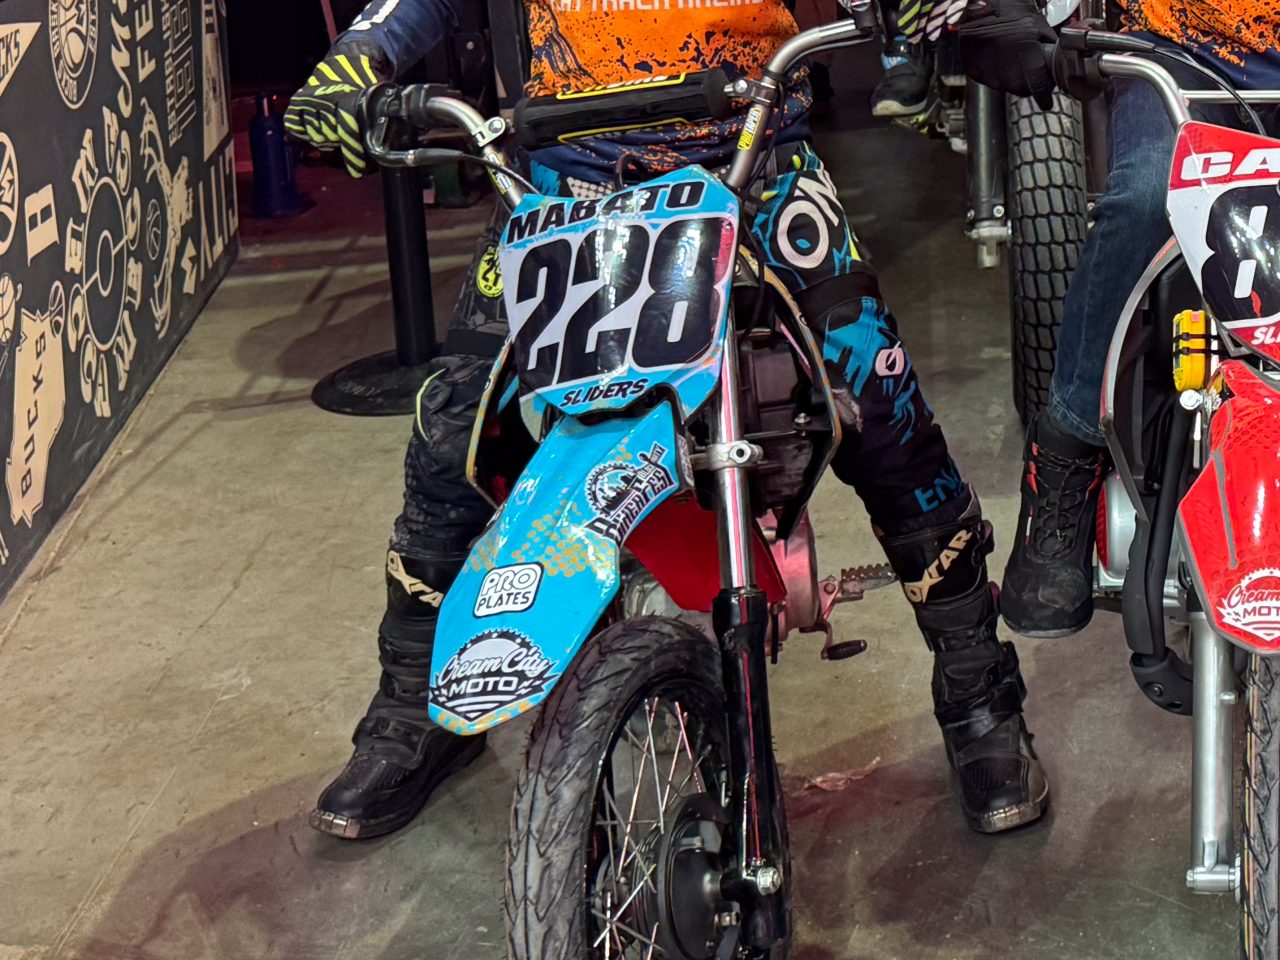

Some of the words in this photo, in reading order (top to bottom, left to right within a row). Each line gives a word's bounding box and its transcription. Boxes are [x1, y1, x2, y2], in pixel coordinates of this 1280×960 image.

[515, 216, 736, 395] 228
[560, 378, 649, 408] SLIDERS
[21, 330, 47, 499] BUCKS
[386, 549, 444, 608] OXTA
[482, 566, 539, 593] PRO
[477, 592, 531, 612] PLATES
[438, 650, 501, 686] Cream
[500, 646, 551, 677] City
[450, 675, 517, 696] MOTO
